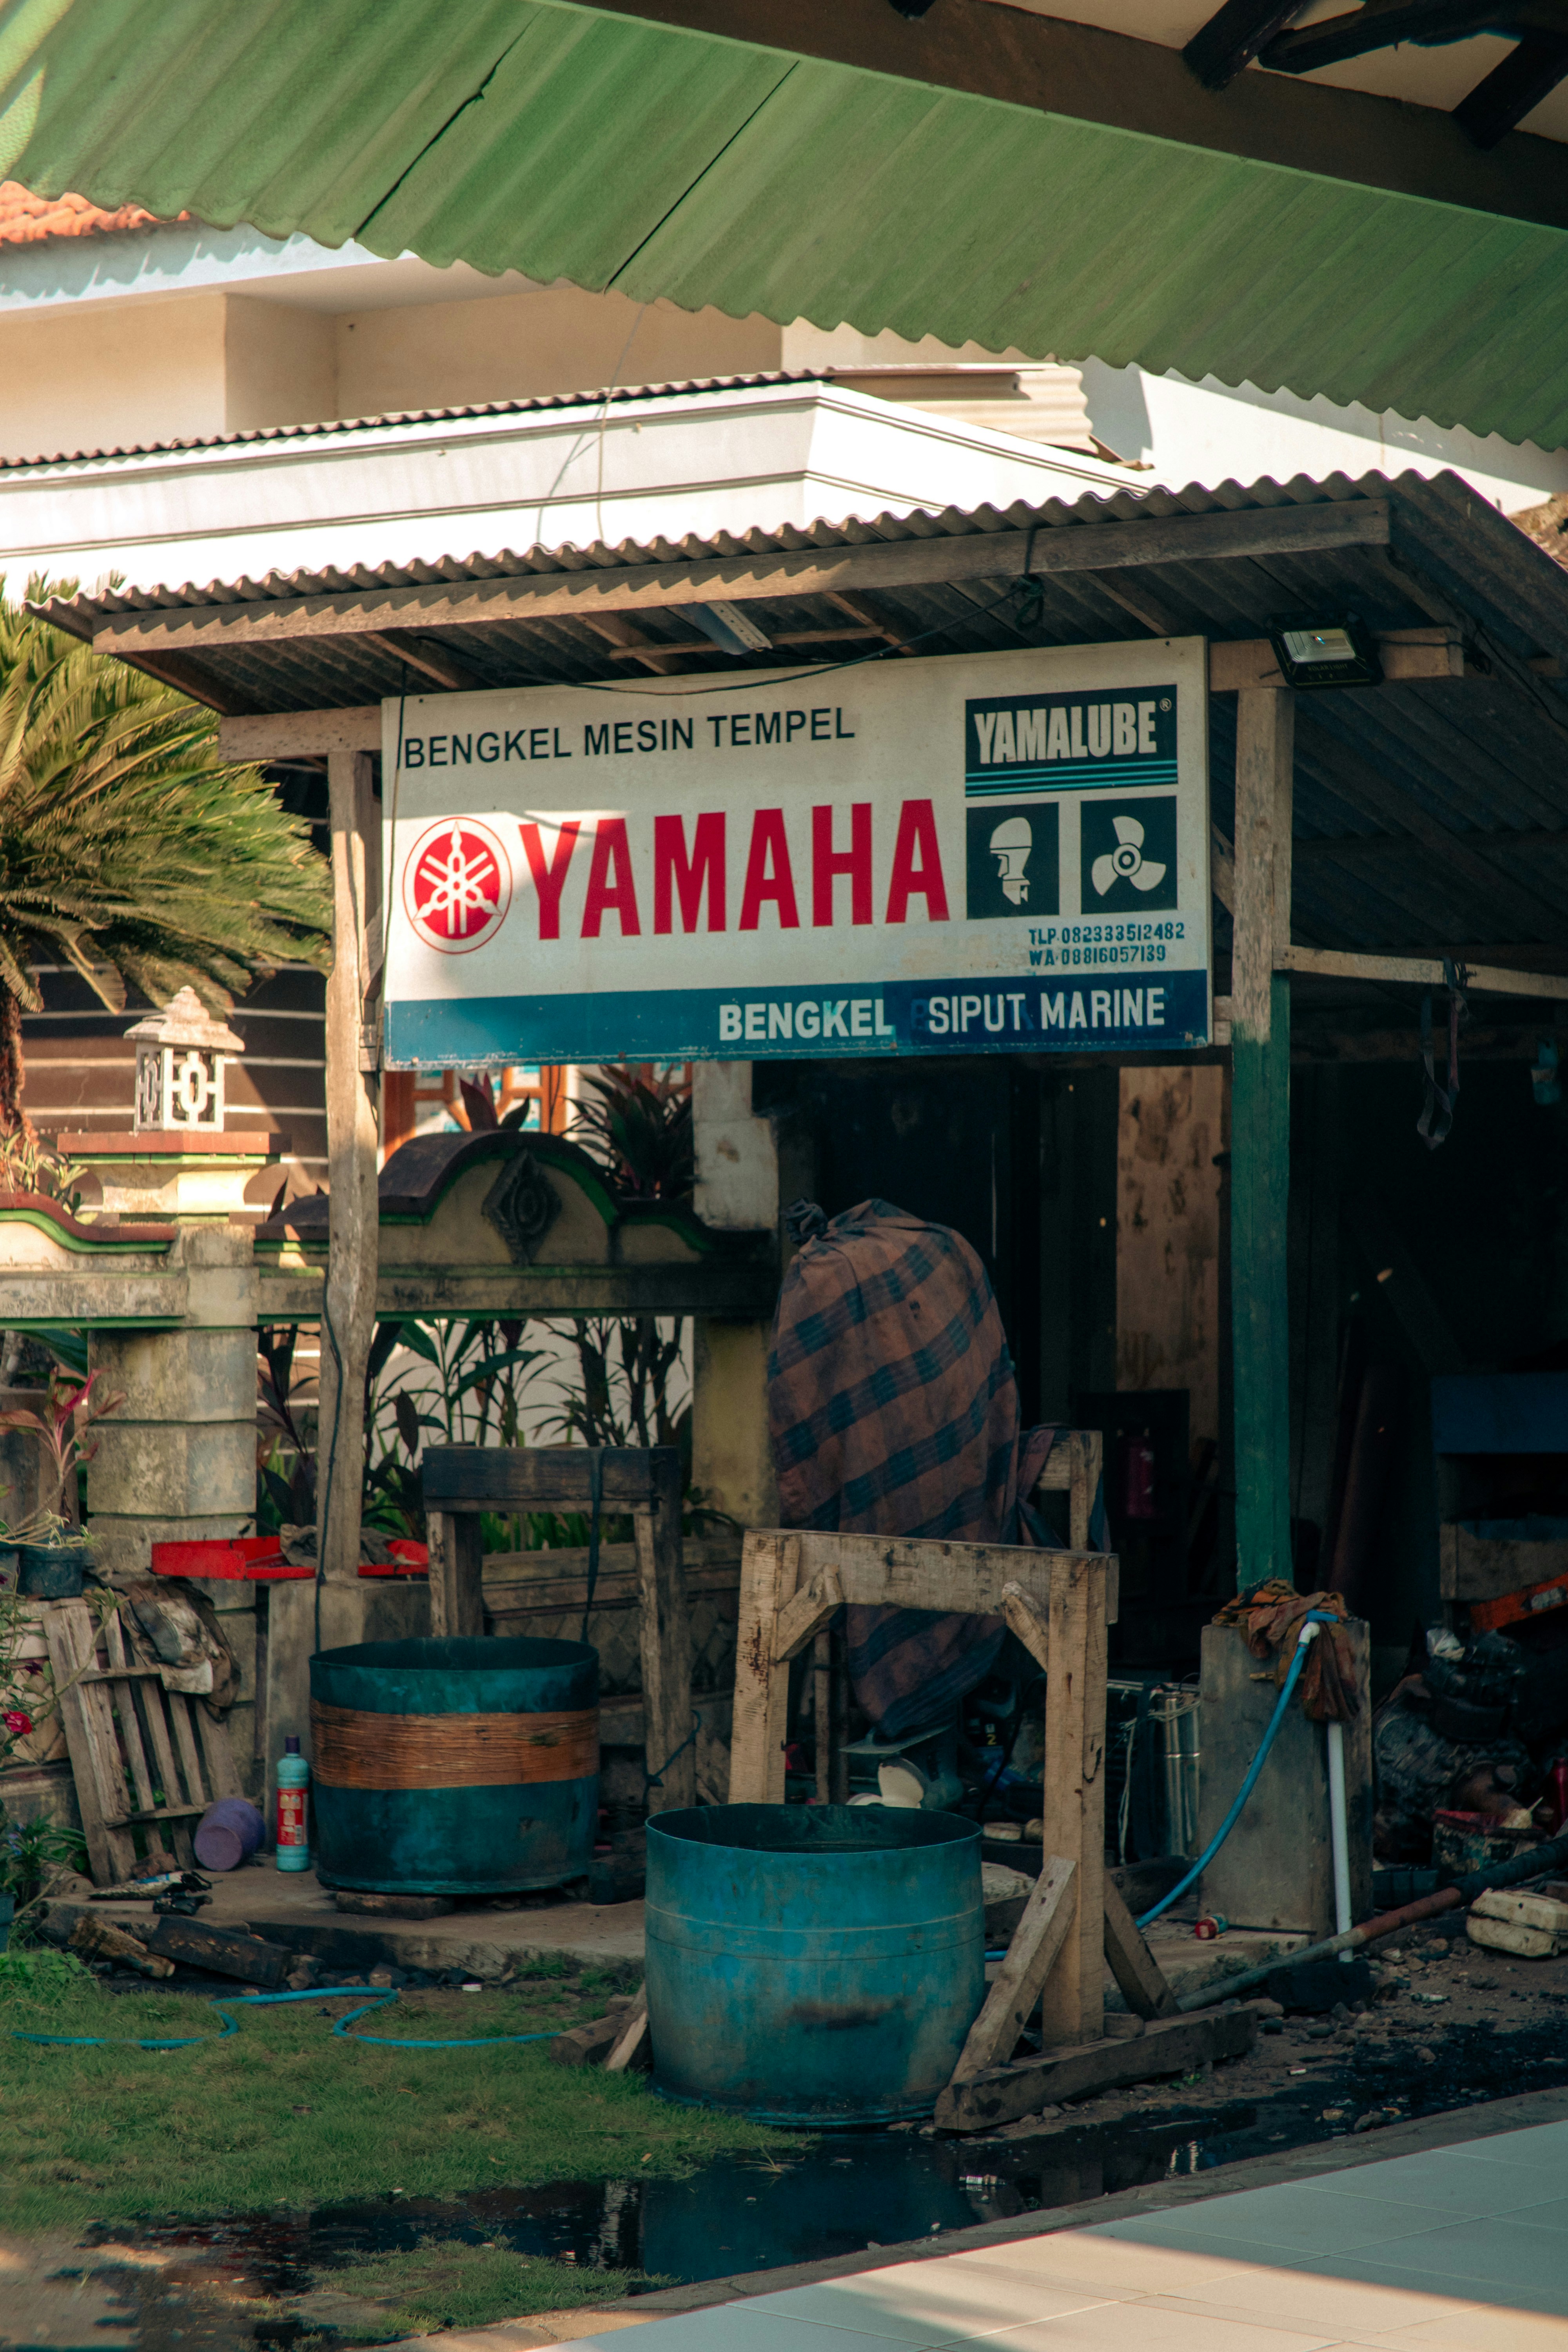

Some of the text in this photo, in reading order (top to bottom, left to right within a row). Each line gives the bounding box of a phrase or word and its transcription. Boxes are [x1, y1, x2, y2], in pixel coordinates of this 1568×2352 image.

[405, 707, 855, 769] BENGKEL MESIN TEMPEL
[517, 799, 949, 940] YAMAHA
[719, 987, 1165, 1041] BENGKEL SIPUT MARINE
